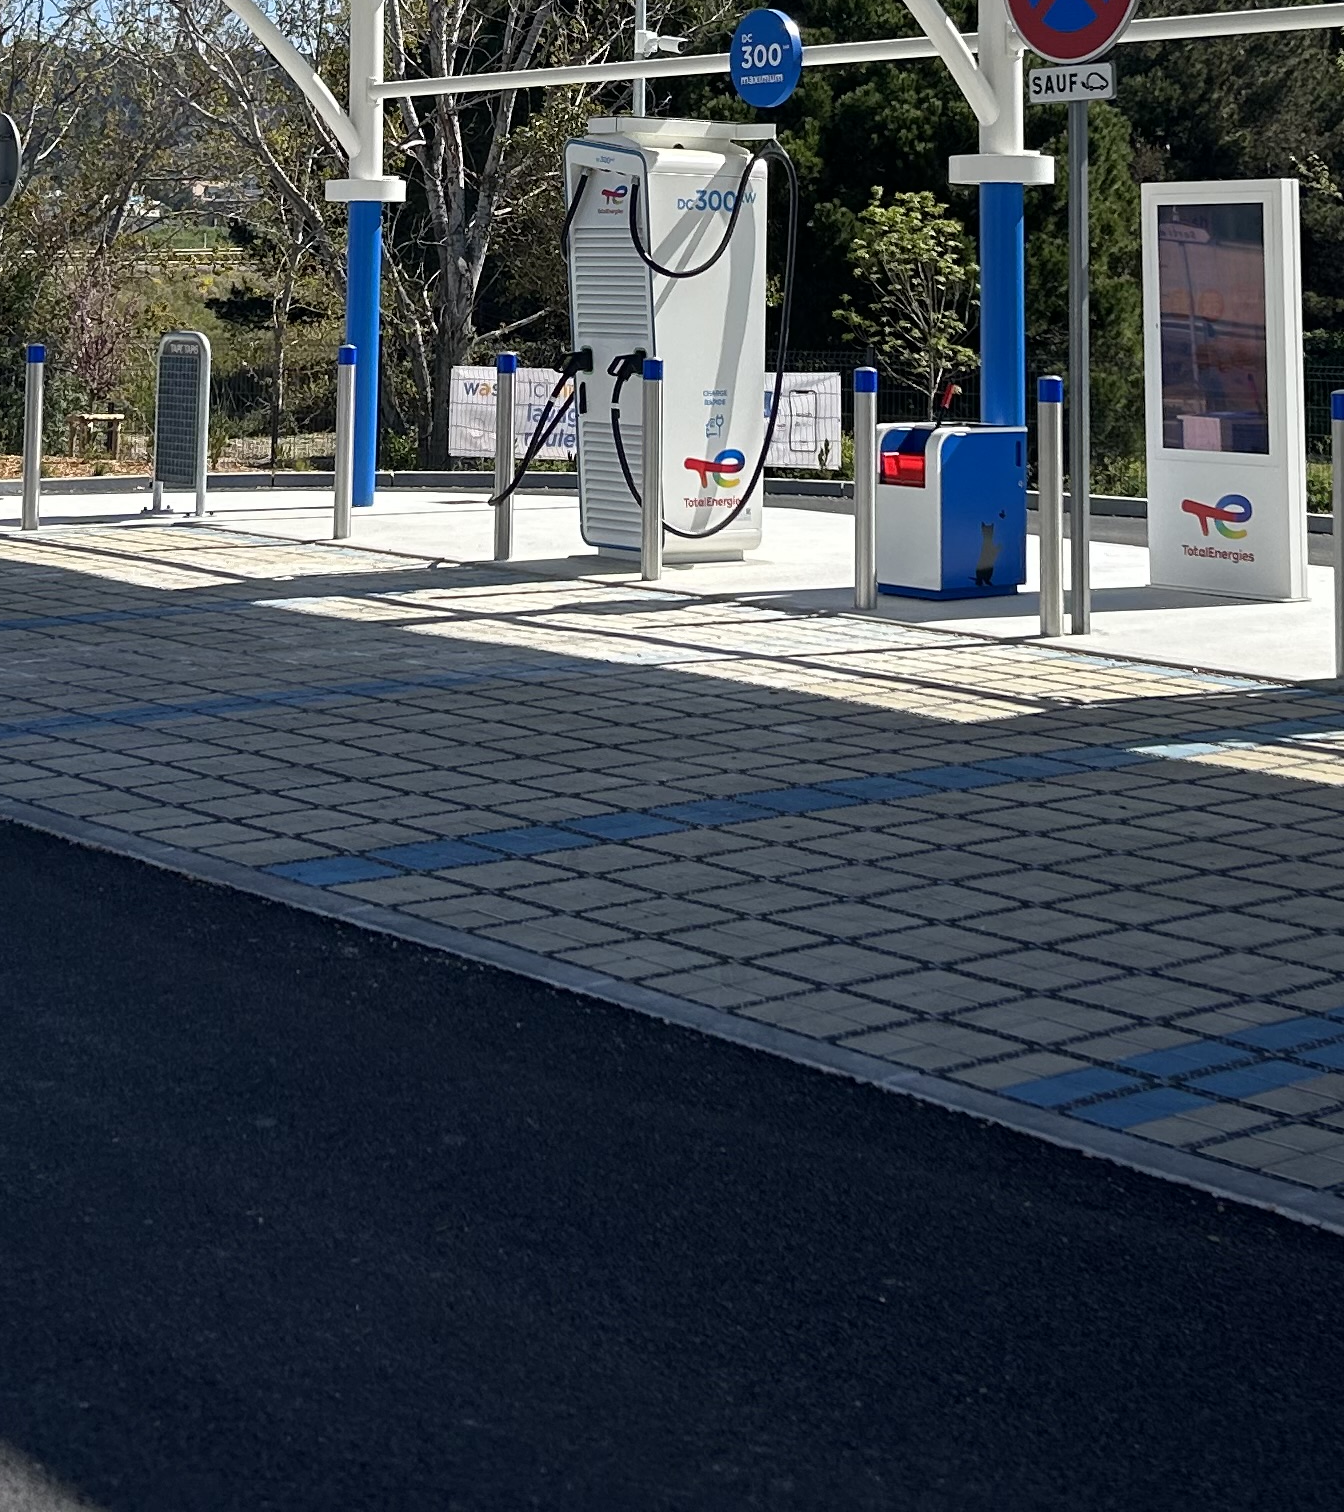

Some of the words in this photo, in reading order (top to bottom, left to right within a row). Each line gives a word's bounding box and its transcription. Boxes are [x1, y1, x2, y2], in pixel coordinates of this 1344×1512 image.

[741, 33, 753, 43] DC
[741, 43, 782, 69] 300
[740, 73, 784, 85] maximum
[1032, 72, 1078, 95] SAUF
[677, 199, 694, 210] DC
[695, 189, 737, 212] 300
[464, 381, 498, 397] was
[683, 494, 742, 509] TotalEnergie
[1181, 544, 1255, 563] TotalEnergies
